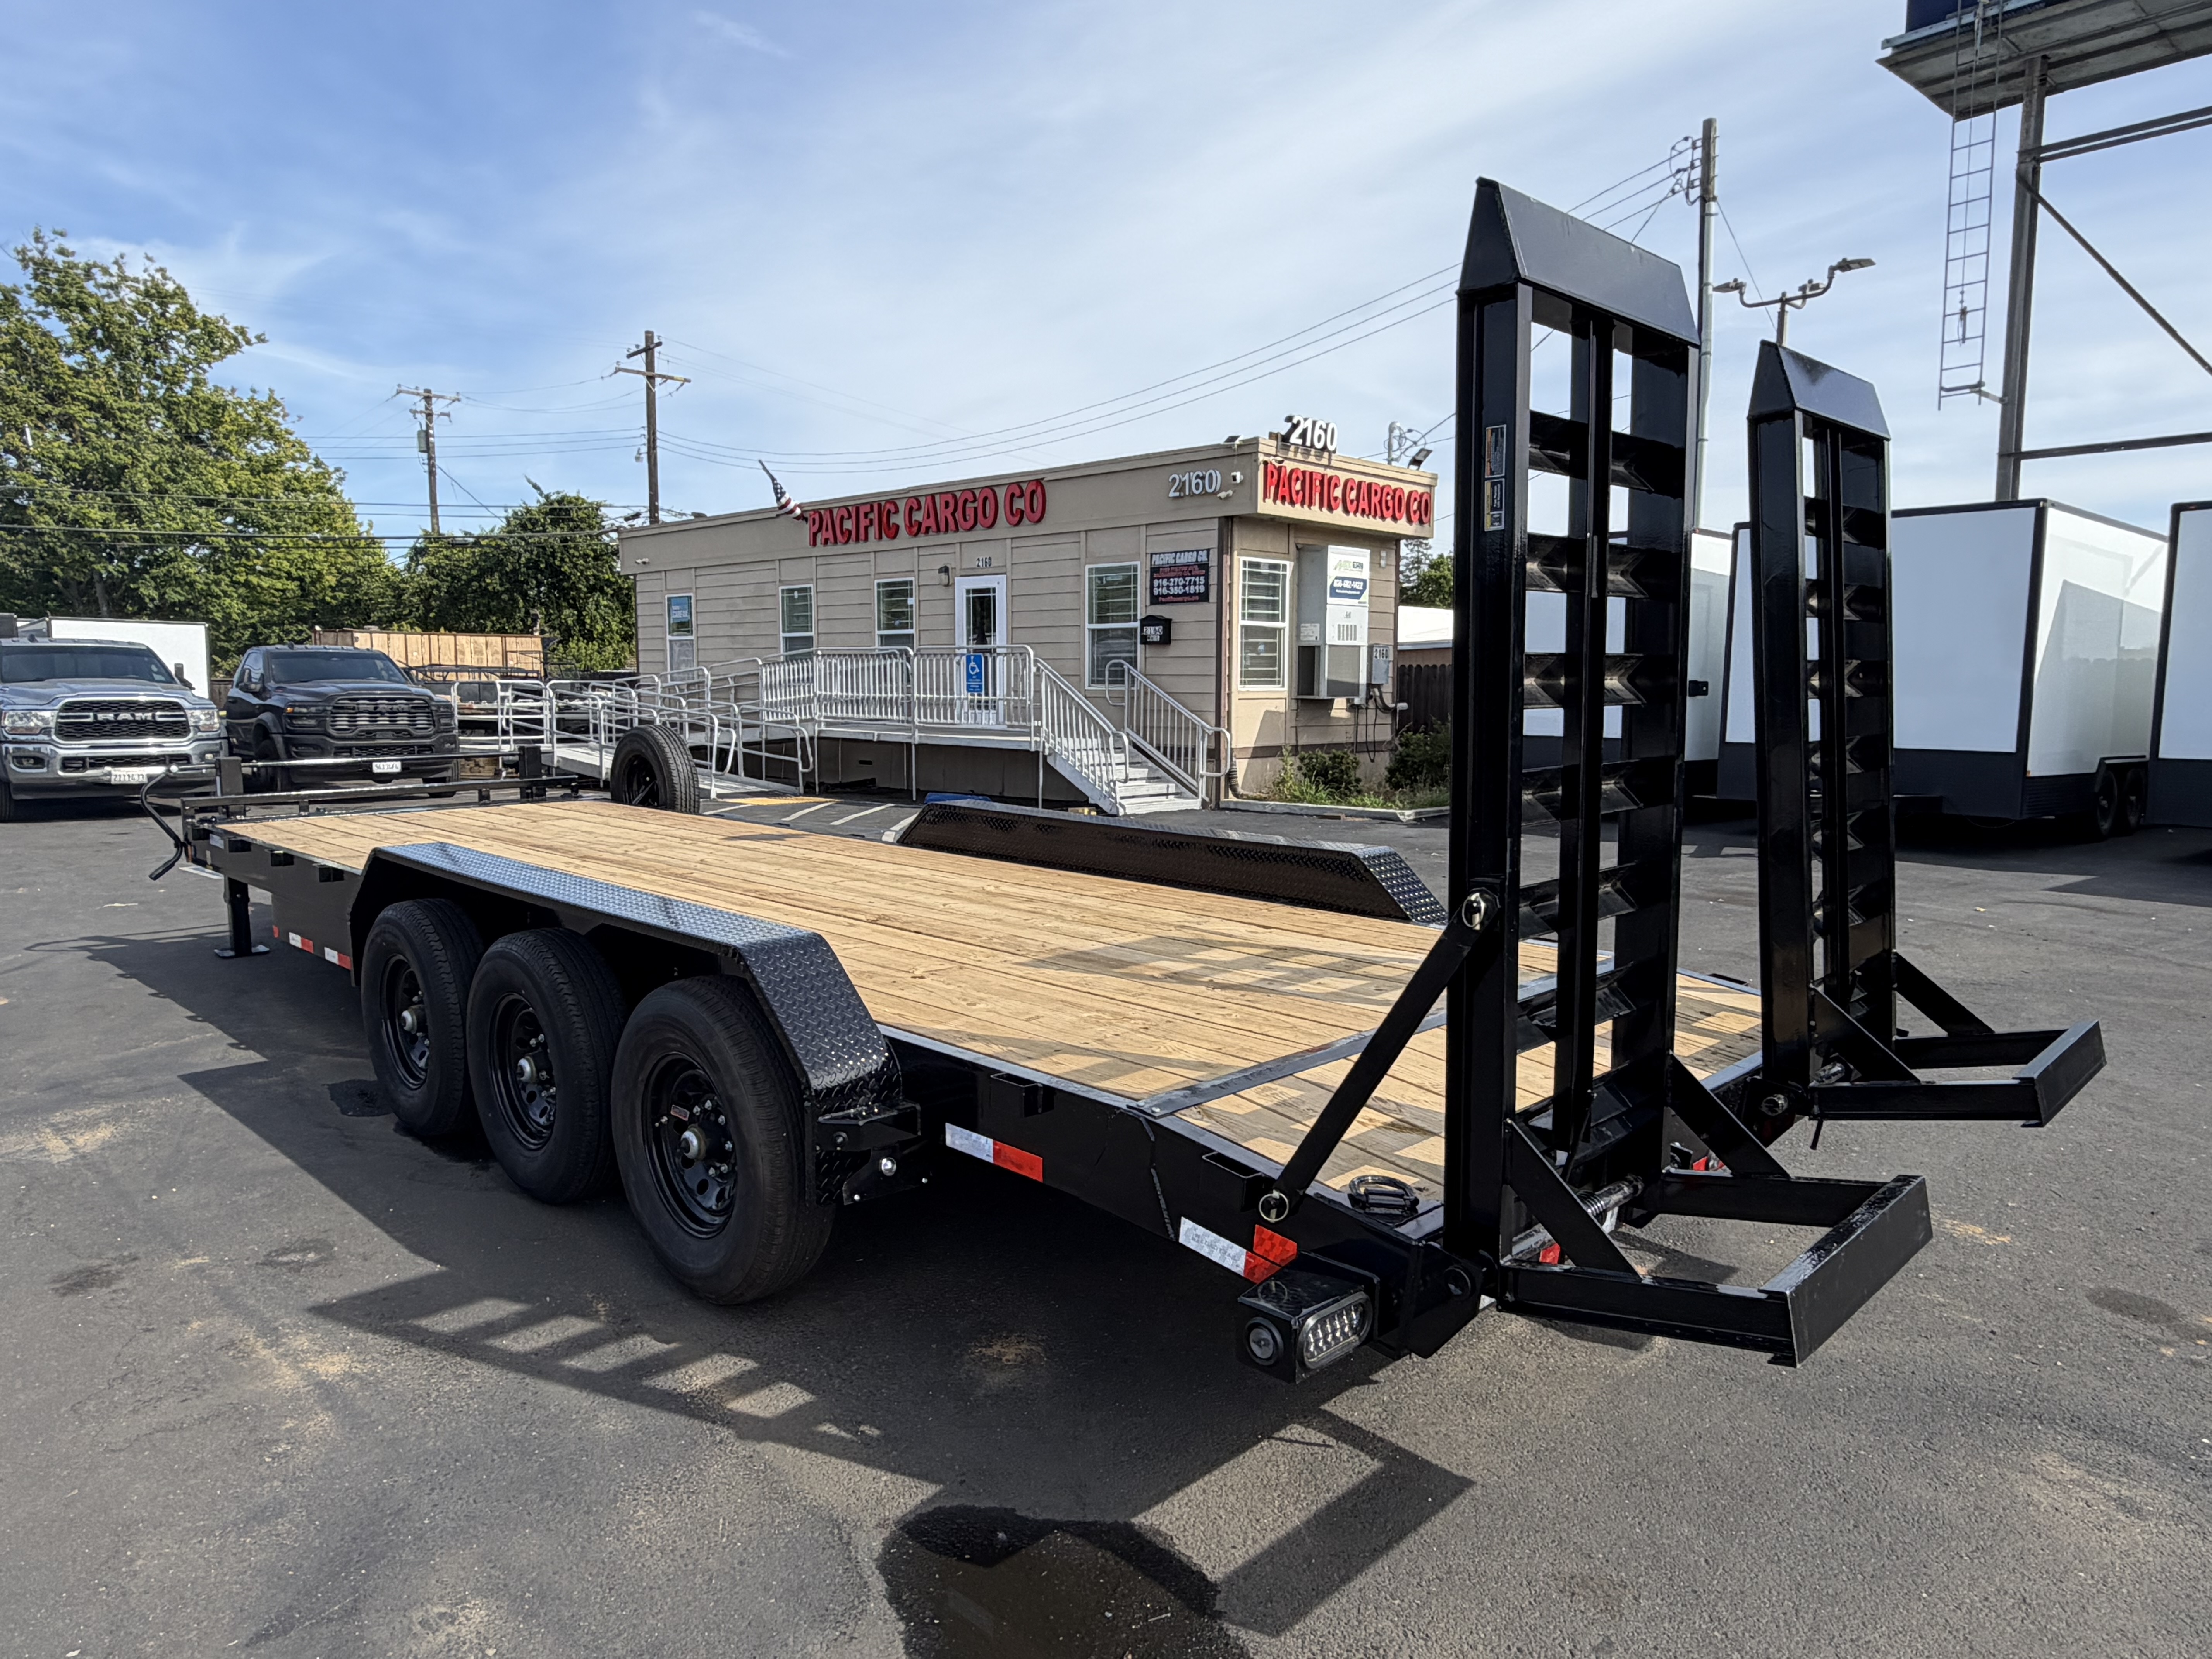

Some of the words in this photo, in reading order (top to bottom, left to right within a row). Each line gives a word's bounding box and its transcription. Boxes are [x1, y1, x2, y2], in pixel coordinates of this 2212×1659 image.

[1289, 415, 1338, 451] 2160
[1169, 469, 1221, 497] 2160
[1263, 461, 1341, 511] PACIFIC
[1343, 478, 1405, 521] CARGO
[1407, 490, 1431, 525] CO
[809, 500, 899, 547] PACIFIC
[904, 487, 998, 537] CARGO
[1004, 479, 1046, 526] CO
[1153, 576, 1205, 587] 916-270-7715
[97, 712, 154, 720] RAM
